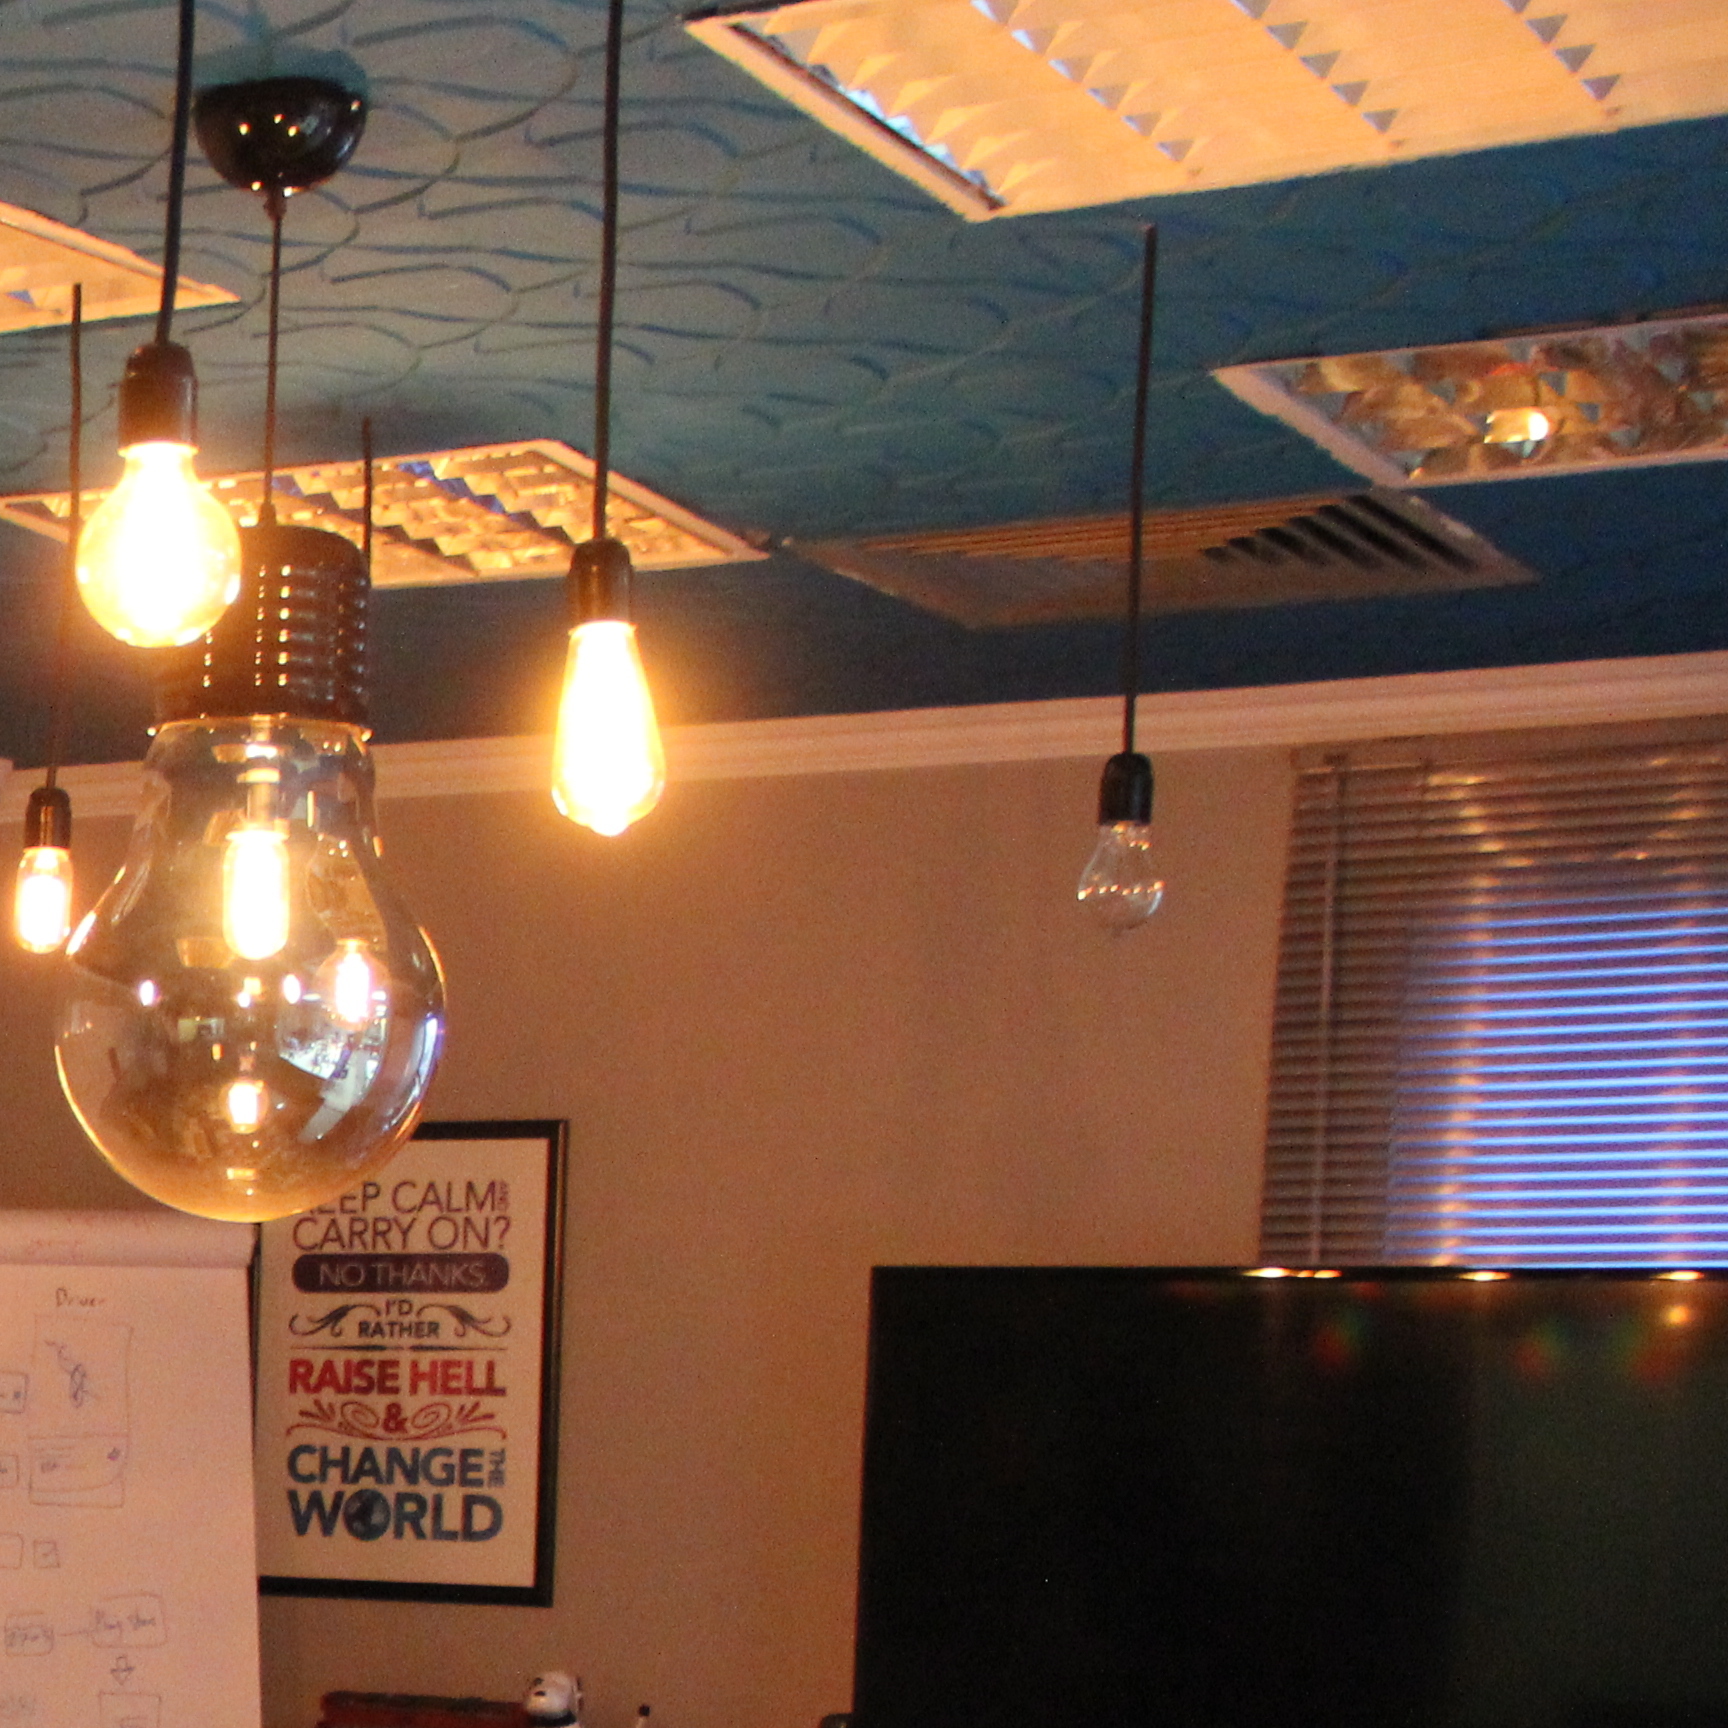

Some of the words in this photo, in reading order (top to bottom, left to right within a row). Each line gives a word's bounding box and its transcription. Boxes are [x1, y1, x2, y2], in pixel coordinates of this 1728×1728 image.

[392, 1181, 496, 1213] CALM
[293, 1217, 417, 1251] CARRY
[427, 1216, 511, 1251] ON?
[319, 1263, 366, 1287] NO
[371, 1263, 487, 1286] THANKS
[384, 1299, 414, 1317] I'D
[357, 1321, 441, 1339] RATHER
[289, 1359, 401, 1395] RAISE
[409, 1359, 508, 1397] HELL
[287, 1444, 486, 1488] CHANGE
[287, 1489, 504, 1542] WORLD
